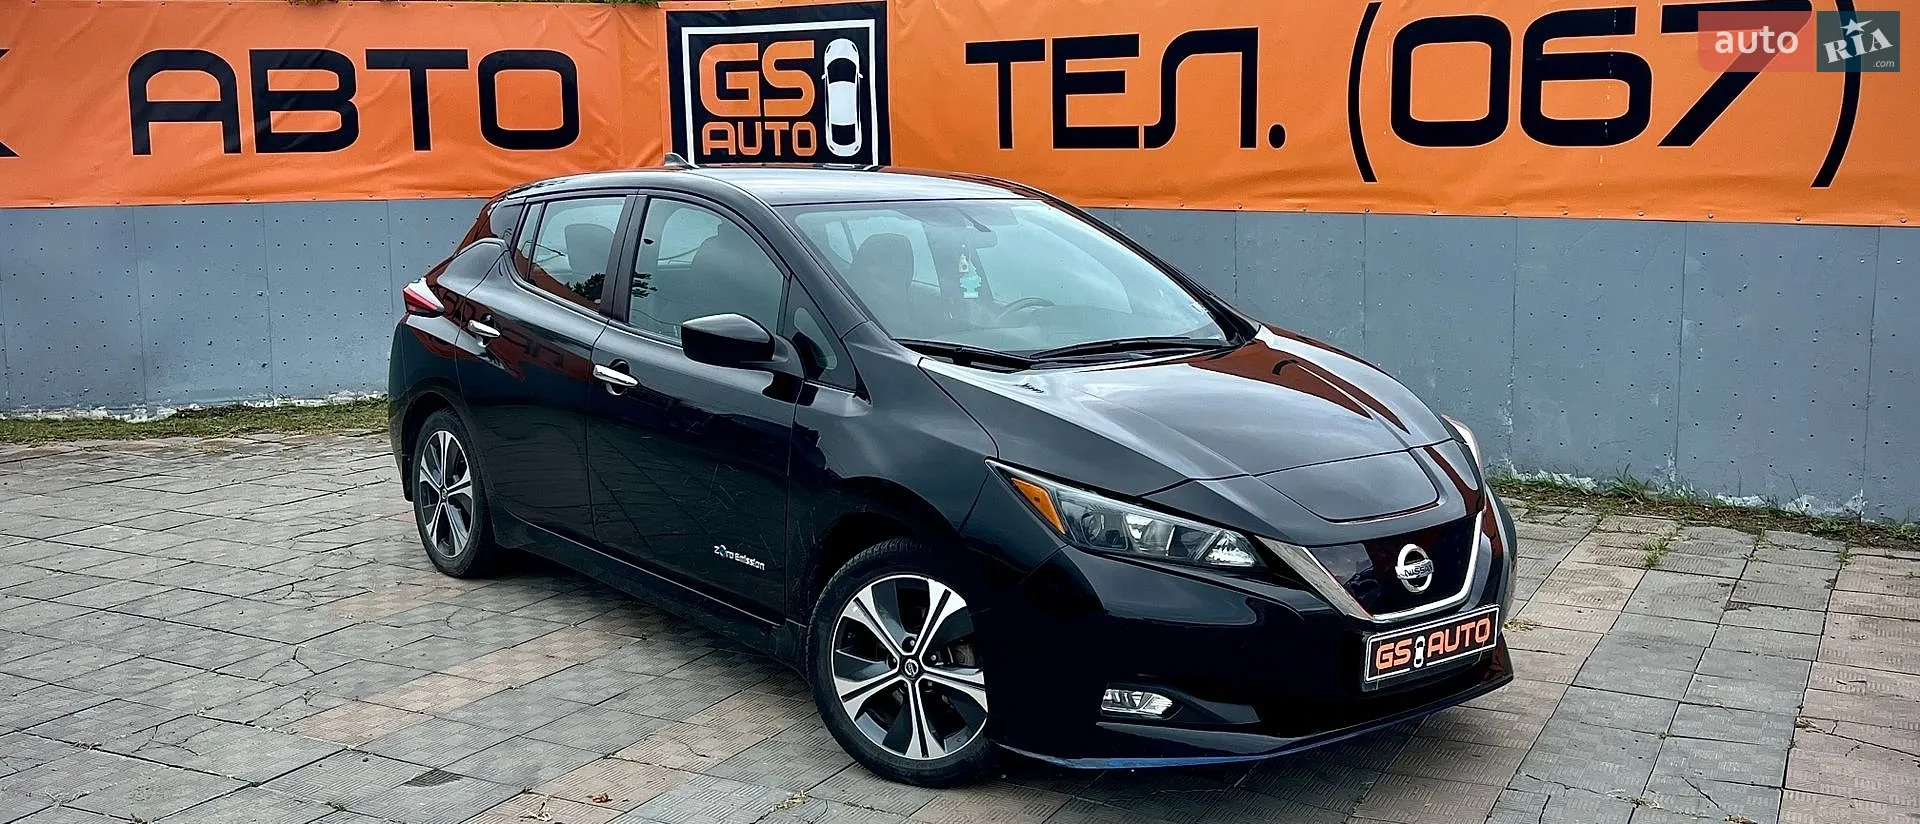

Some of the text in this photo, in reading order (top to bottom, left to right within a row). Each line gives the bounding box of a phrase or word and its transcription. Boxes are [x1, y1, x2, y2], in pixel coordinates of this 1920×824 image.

[128, 48, 579, 156] АВТО
[699, 40, 815, 118] GS
[965, 0, 1862, 189] ТЕЛ. (067)
[701, 121, 817, 157] AUTO
[1375, 618, 1491, 670] GS AUTO
